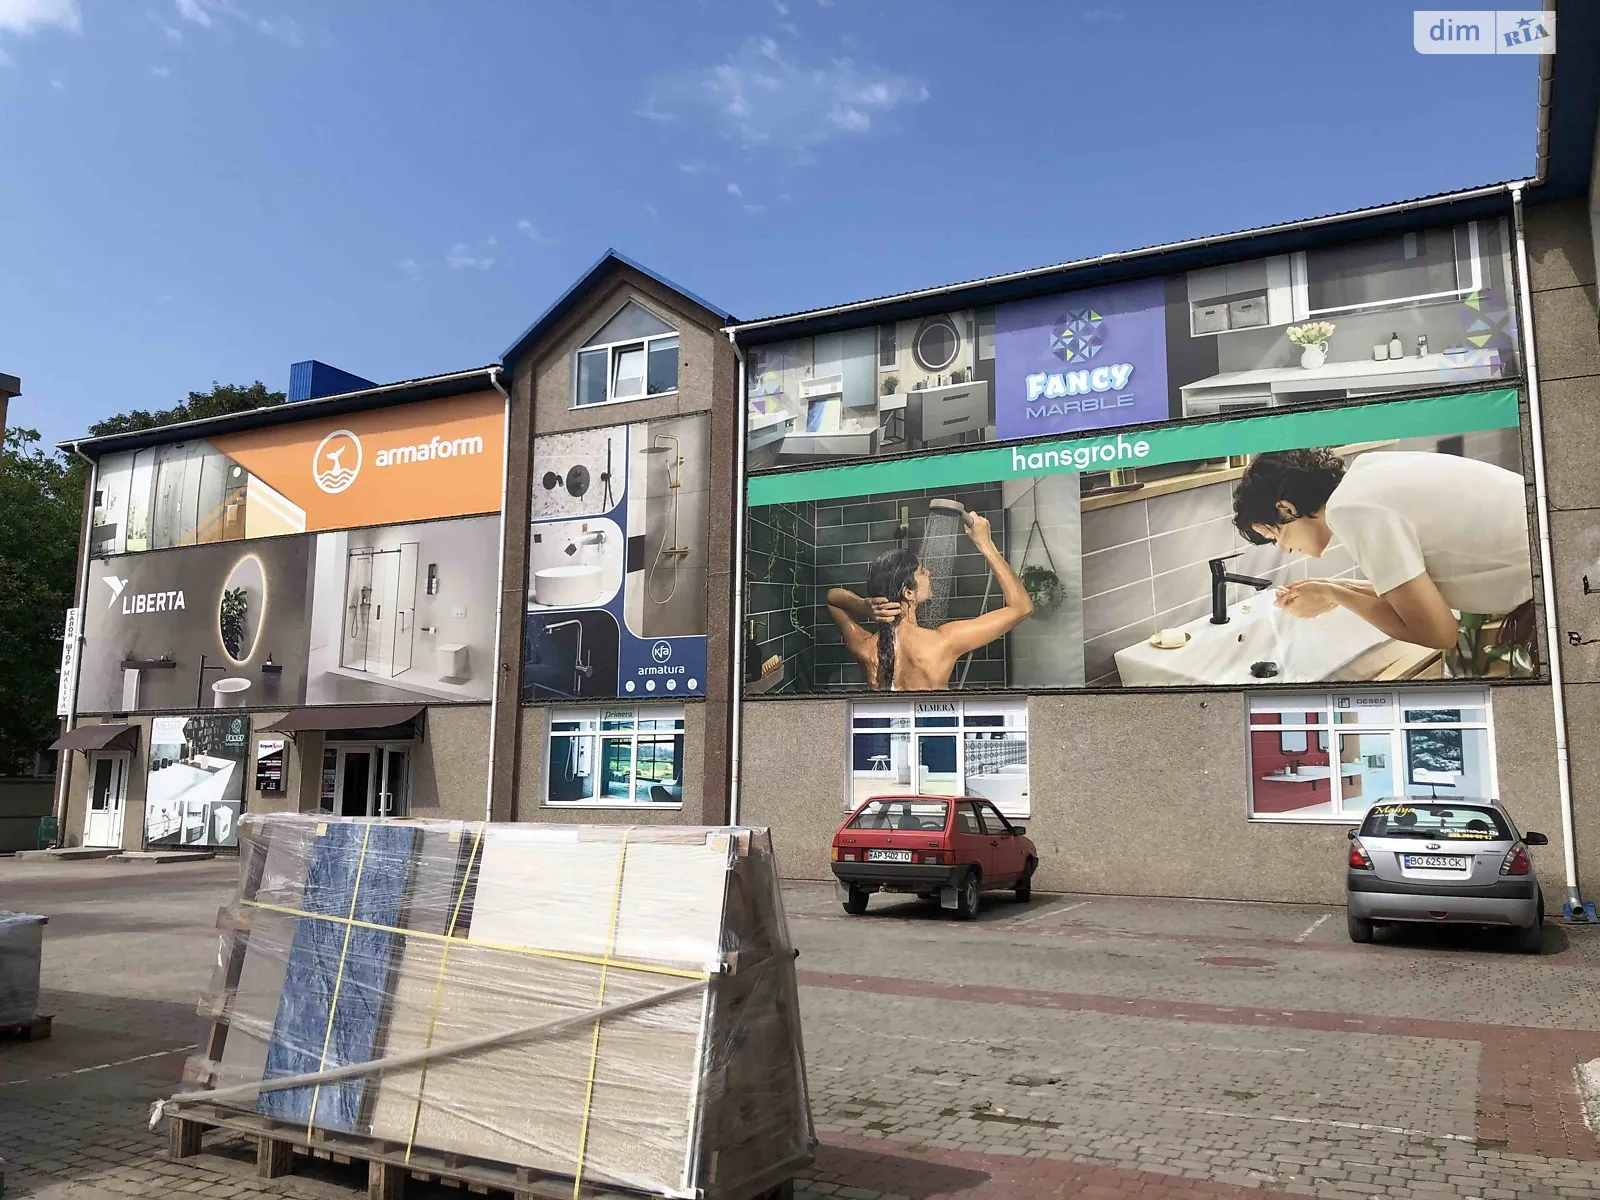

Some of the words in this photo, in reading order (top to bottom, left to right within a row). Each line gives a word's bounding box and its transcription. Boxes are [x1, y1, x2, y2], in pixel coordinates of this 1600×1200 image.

[1025, 363, 1134, 402] FANCY
[1026, 393, 1135, 419] MARBLE
[375, 435, 483, 467] armaform
[1012, 434, 1150, 471] hansgrohe
[122, 590, 186, 615] LIBERTA
[637, 665, 686, 676] armatura
[916, 703, 956, 712] ALMERA
[872, 850, 882, 859] AP
[883, 851, 899, 860] 3402
[1410, 857, 1423, 866] BO
[1425, 856, 1447, 867] 6253
[1448, 857, 1462, 867] CK
